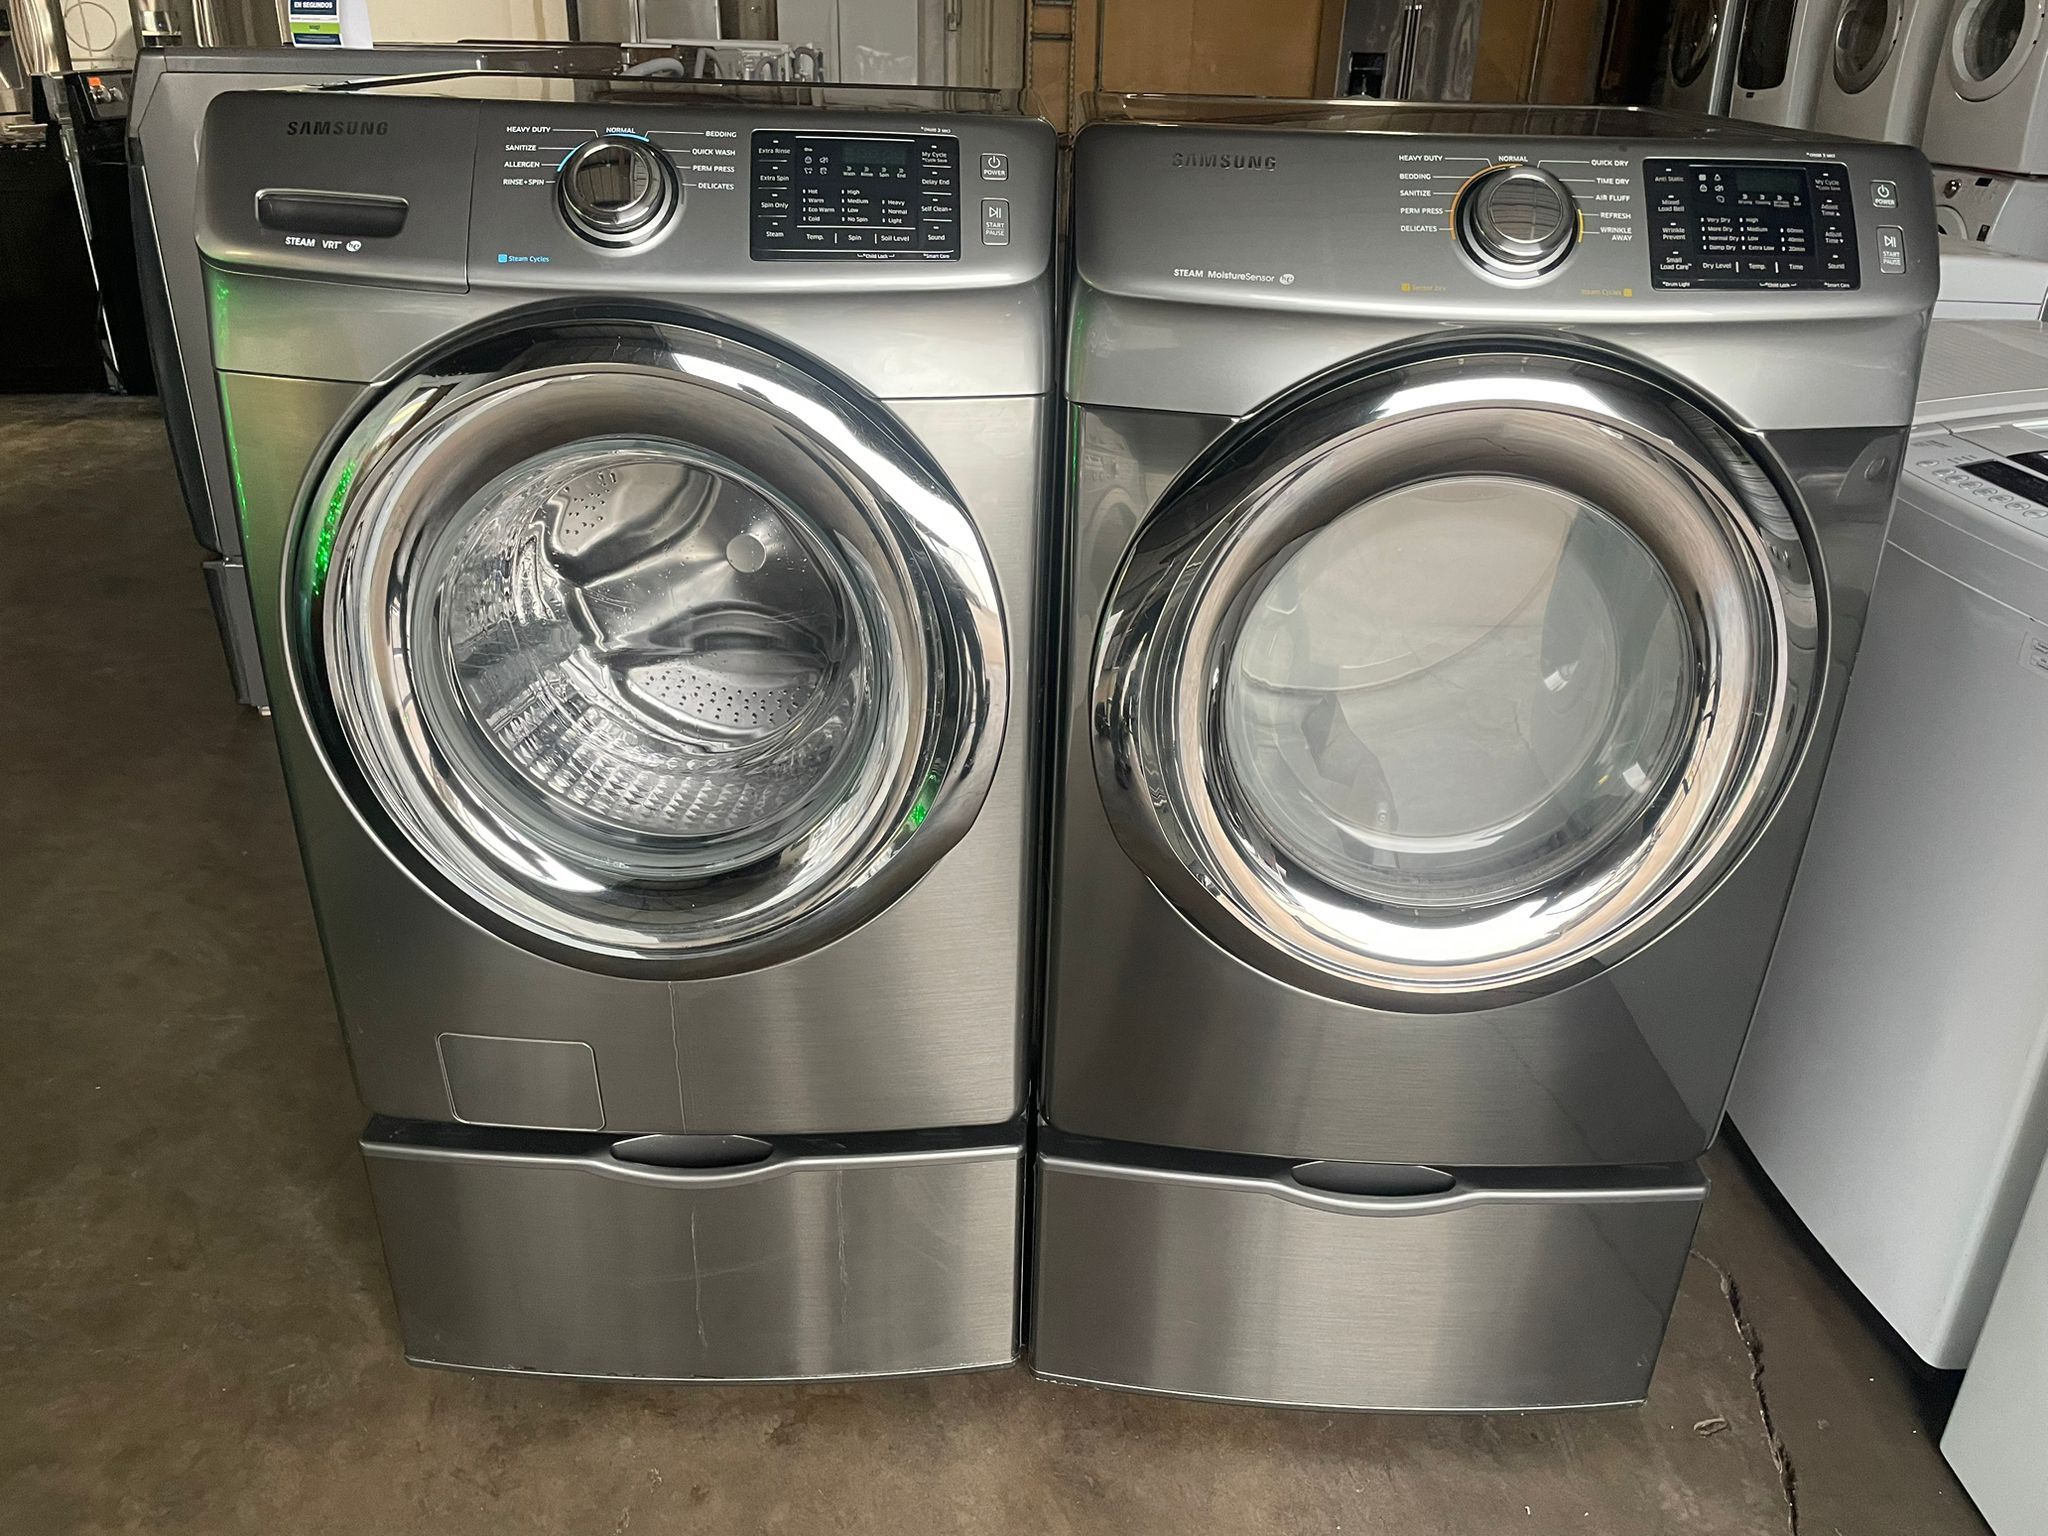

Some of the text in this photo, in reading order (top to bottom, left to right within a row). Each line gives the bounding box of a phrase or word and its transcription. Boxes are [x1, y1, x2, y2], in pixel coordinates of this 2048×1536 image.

[293, 1, 333, 9] EN SEGUNDOS
[286, 121, 389, 136] SAMSUNG
[506, 126, 531, 134] HEAVY
[605, 127, 636, 135] NORMAL
[705, 130, 737, 138] BEDDING
[505, 144, 537, 152] SANITIZE
[758, 147, 774, 155] Extra
[691, 148, 736, 157] QUICK WASH
[931, 151, 947, 159] Cycle
[1171, 152, 1277, 171] SAMSUNG
[1398, 154, 1443, 162] HEAVY DUTY
[1498, 155, 1529, 163] NORMAL
[1590, 159, 1629, 167] QUICK DRY
[692, 165, 735, 173] PERM PRESS
[1399, 173, 1432, 181] BEDDING
[1596, 177, 1630, 186] TIME DRY
[697, 182, 735, 191] DELICATES
[1399, 189, 1432, 197] SANITIZE
[1595, 194, 1631, 202] AIR FLUFF
[774, 202, 789, 210] Only
[1400, 207, 1444, 215] PERM PRESS
[1600, 212, 1632, 220] REFRESH
[985, 221, 1005, 229] START
[1400, 225, 1438, 233] DELICATES
[985, 229, 1005, 237] PAUSE
[1600, 227, 1633, 235] WRINKLE
[284, 236, 316, 248] STEAM
[848, 234, 862, 242] Spin
[1611, 234, 1633, 242] AWAY
[1725, 244, 1737, 252] Dry
[1882, 250, 1900, 258] START
[529, 255, 550, 264] Cycles
[1702, 262, 1715, 270] Dry
[1173, 268, 1204, 279] STEAM
[1207, 270, 1275, 283] MoistureSensor
